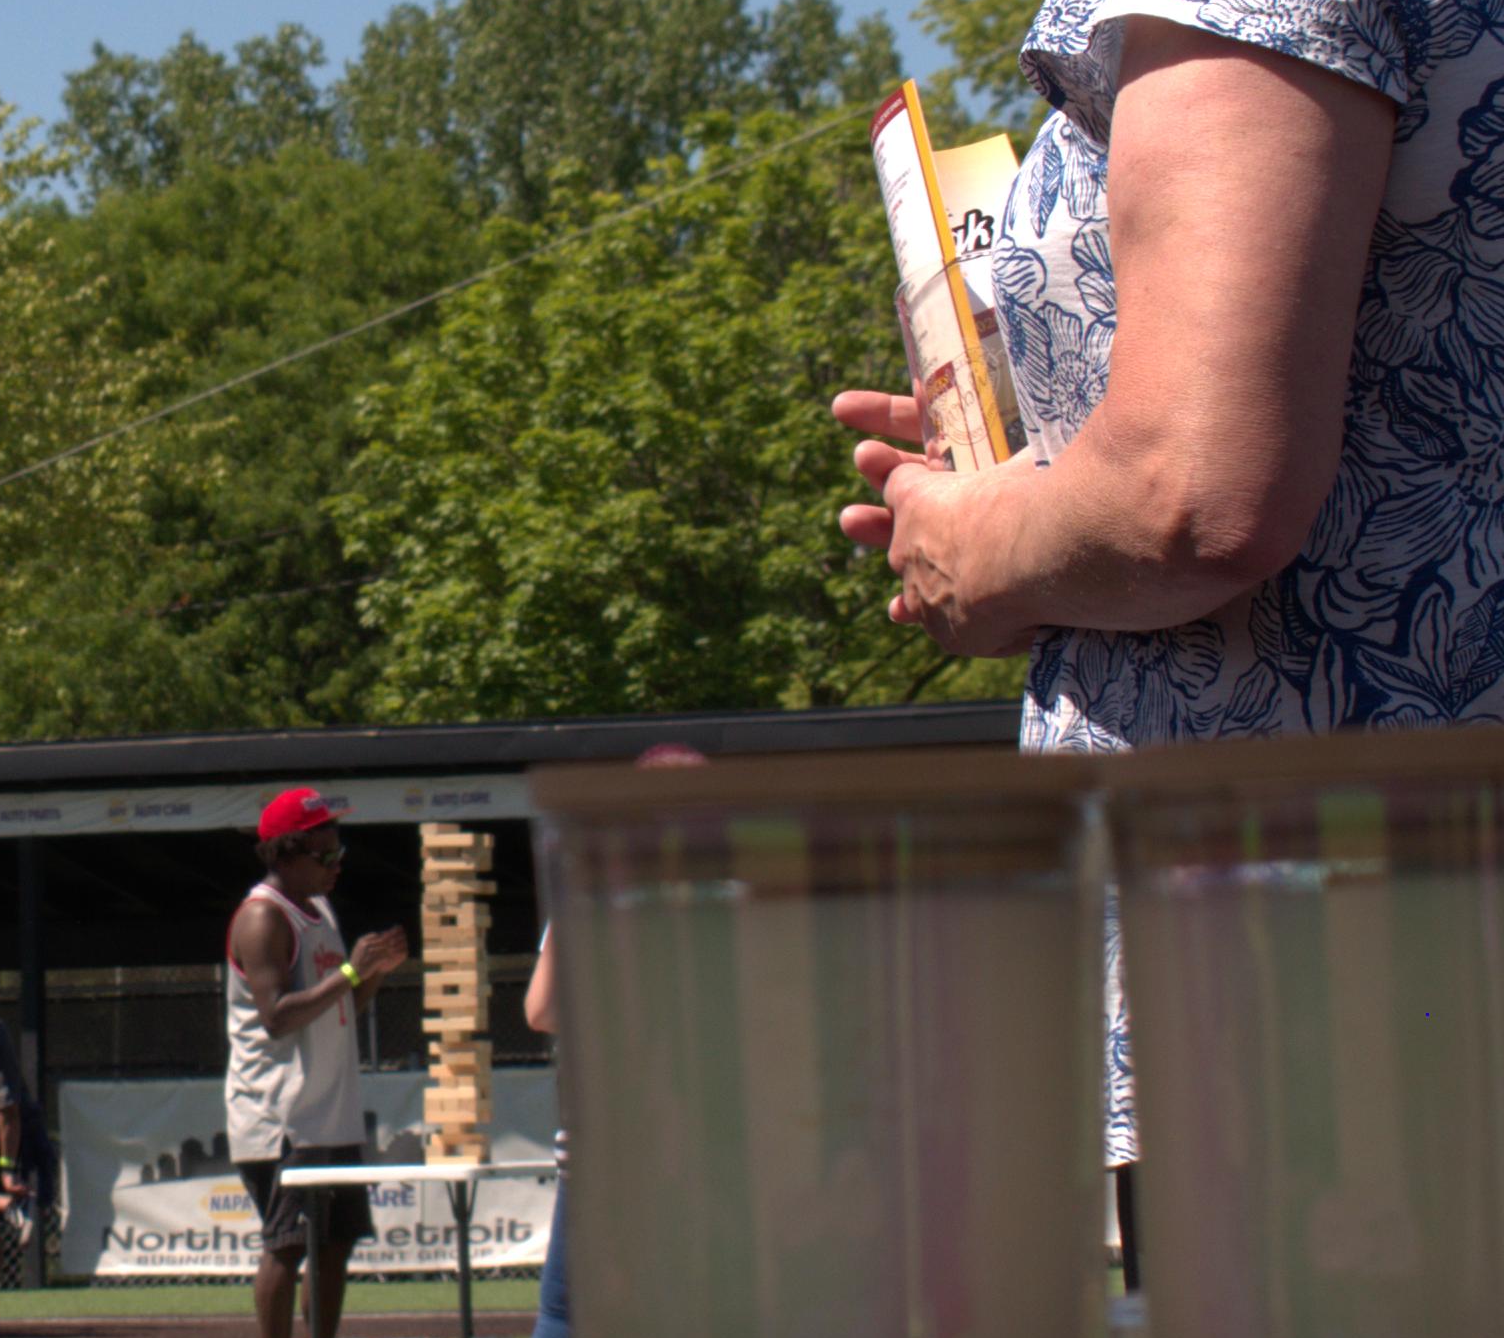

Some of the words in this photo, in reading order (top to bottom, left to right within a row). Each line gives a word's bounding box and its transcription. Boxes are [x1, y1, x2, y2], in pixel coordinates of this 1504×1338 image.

[210, 1195, 263, 1215] NAPA
[102, 1225, 264, 1251] Northe
[136, 1253, 241, 1266] BUSINESS
